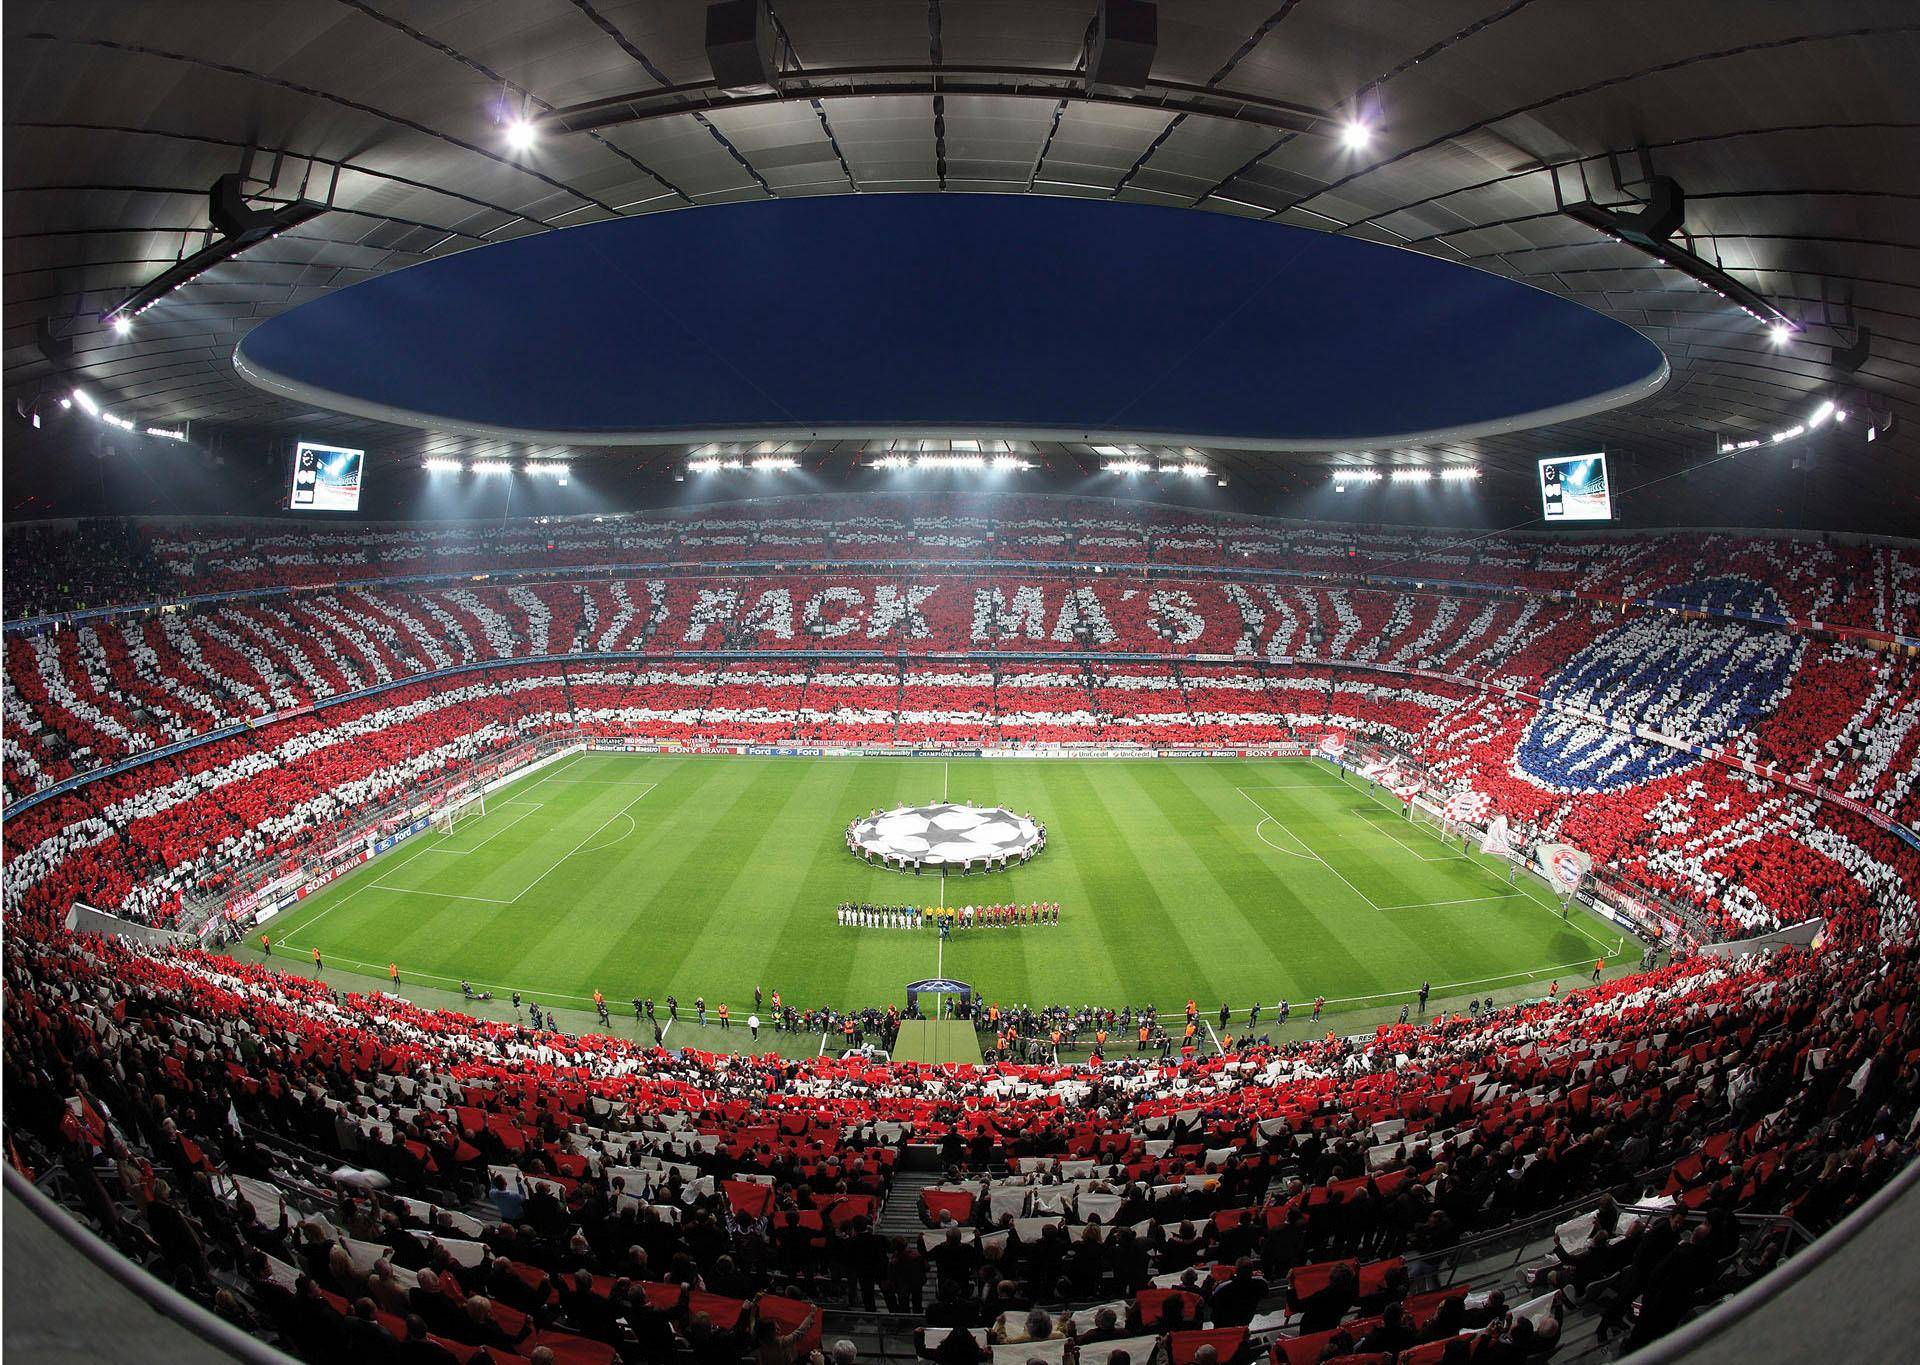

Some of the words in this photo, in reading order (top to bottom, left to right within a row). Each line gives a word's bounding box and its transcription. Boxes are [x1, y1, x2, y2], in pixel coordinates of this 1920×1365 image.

[683, 585, 939, 641] PACK
[970, 586, 1206, 644] MA'S
[749, 747, 771, 755] Ford
[797, 748, 819, 756] Ford
[865, 749, 879, 757] Enjoy
[880, 749, 911, 757] Responsibly
[1246, 749, 1274, 757] SONY
[1278, 749, 1304, 757] BRAVIA
[395, 827, 412, 843] Ford
[304, 872, 333, 894] SONY
[335, 856, 362, 877] BRAVIA
